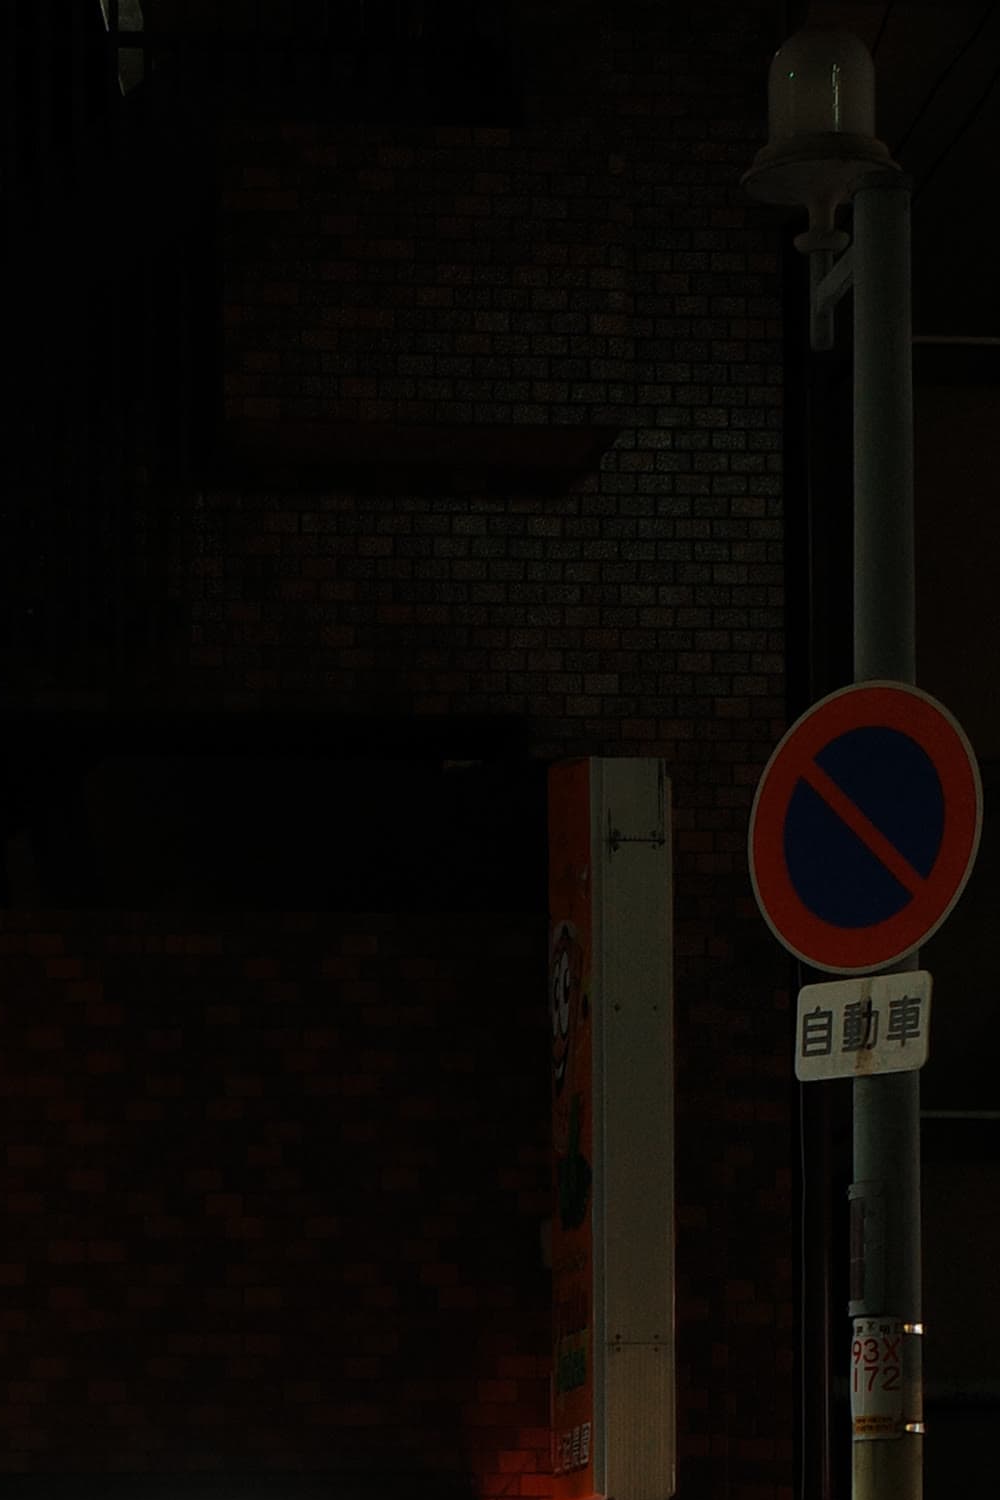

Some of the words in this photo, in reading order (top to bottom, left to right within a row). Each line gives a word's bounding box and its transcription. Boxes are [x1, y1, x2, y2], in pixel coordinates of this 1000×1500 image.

[801, 996, 922, 1058] 自動車
[852, 1338, 901, 1365] 93X
[853, 1366, 901, 1393] 172
